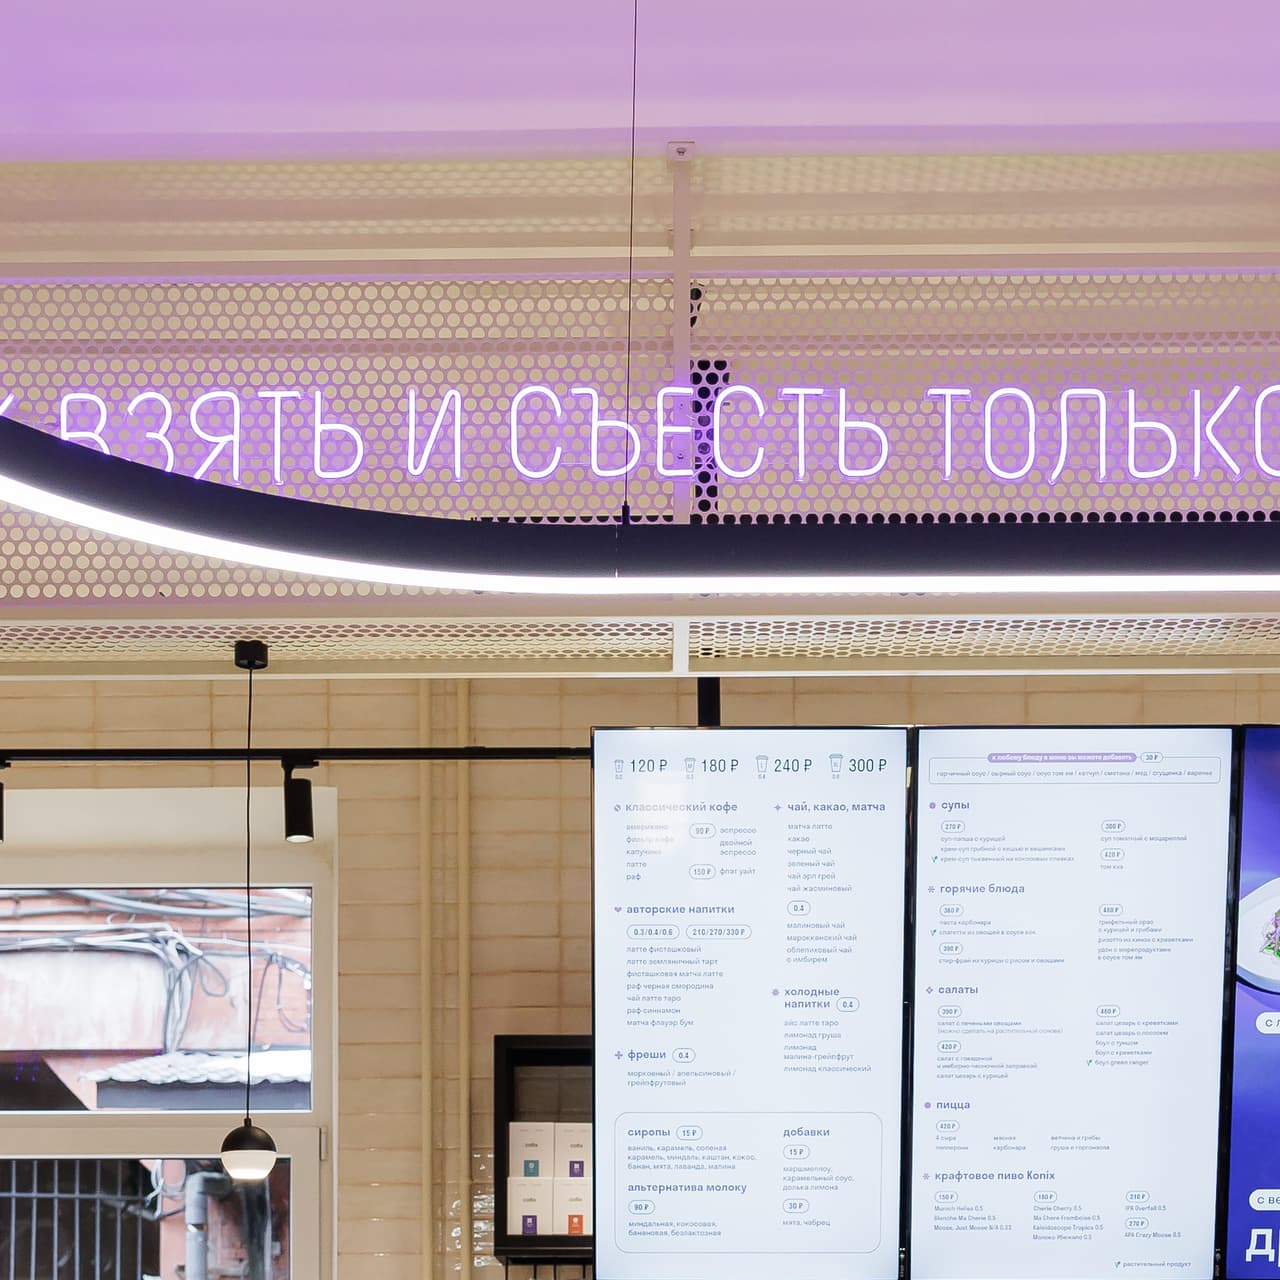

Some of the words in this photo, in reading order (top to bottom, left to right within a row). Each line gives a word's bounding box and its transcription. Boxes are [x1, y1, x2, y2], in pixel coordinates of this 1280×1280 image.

[58, 390, 365, 485] ВЗЯТЬ
[408, 389, 463, 484] И
[509, 384, 890, 482] СЪЕСТЬ
[631, 759, 654, 772] 120
[702, 759, 726, 772] 180
[775, 759, 799, 772] 240
[849, 759, 873, 772] 300
[626, 801, 706, 811] классический
[710, 801, 737, 814] кофе
[814, 804, 848, 812] какао,
[941, 802, 969, 812] супы
[940, 886, 985, 896] горячие
[989, 883, 1024, 894] блюда
[627, 907, 685, 916] авторские
[785, 989, 839, 997] холодные
[1265, 1019, 1274, 1027] с
[628, 1049, 666, 1061] фреши
[937, 1102, 970, 1110] пицца
[628, 1130, 670, 1139] сиропы
[784, 1127, 829, 1137] добавки
[935, 1171, 994, 1182] крафтовое
[1027, 1170, 1055, 1179] Konix
[628, 1185, 703, 1194] альтернатива
[706, 1185, 746, 1194] молоку
